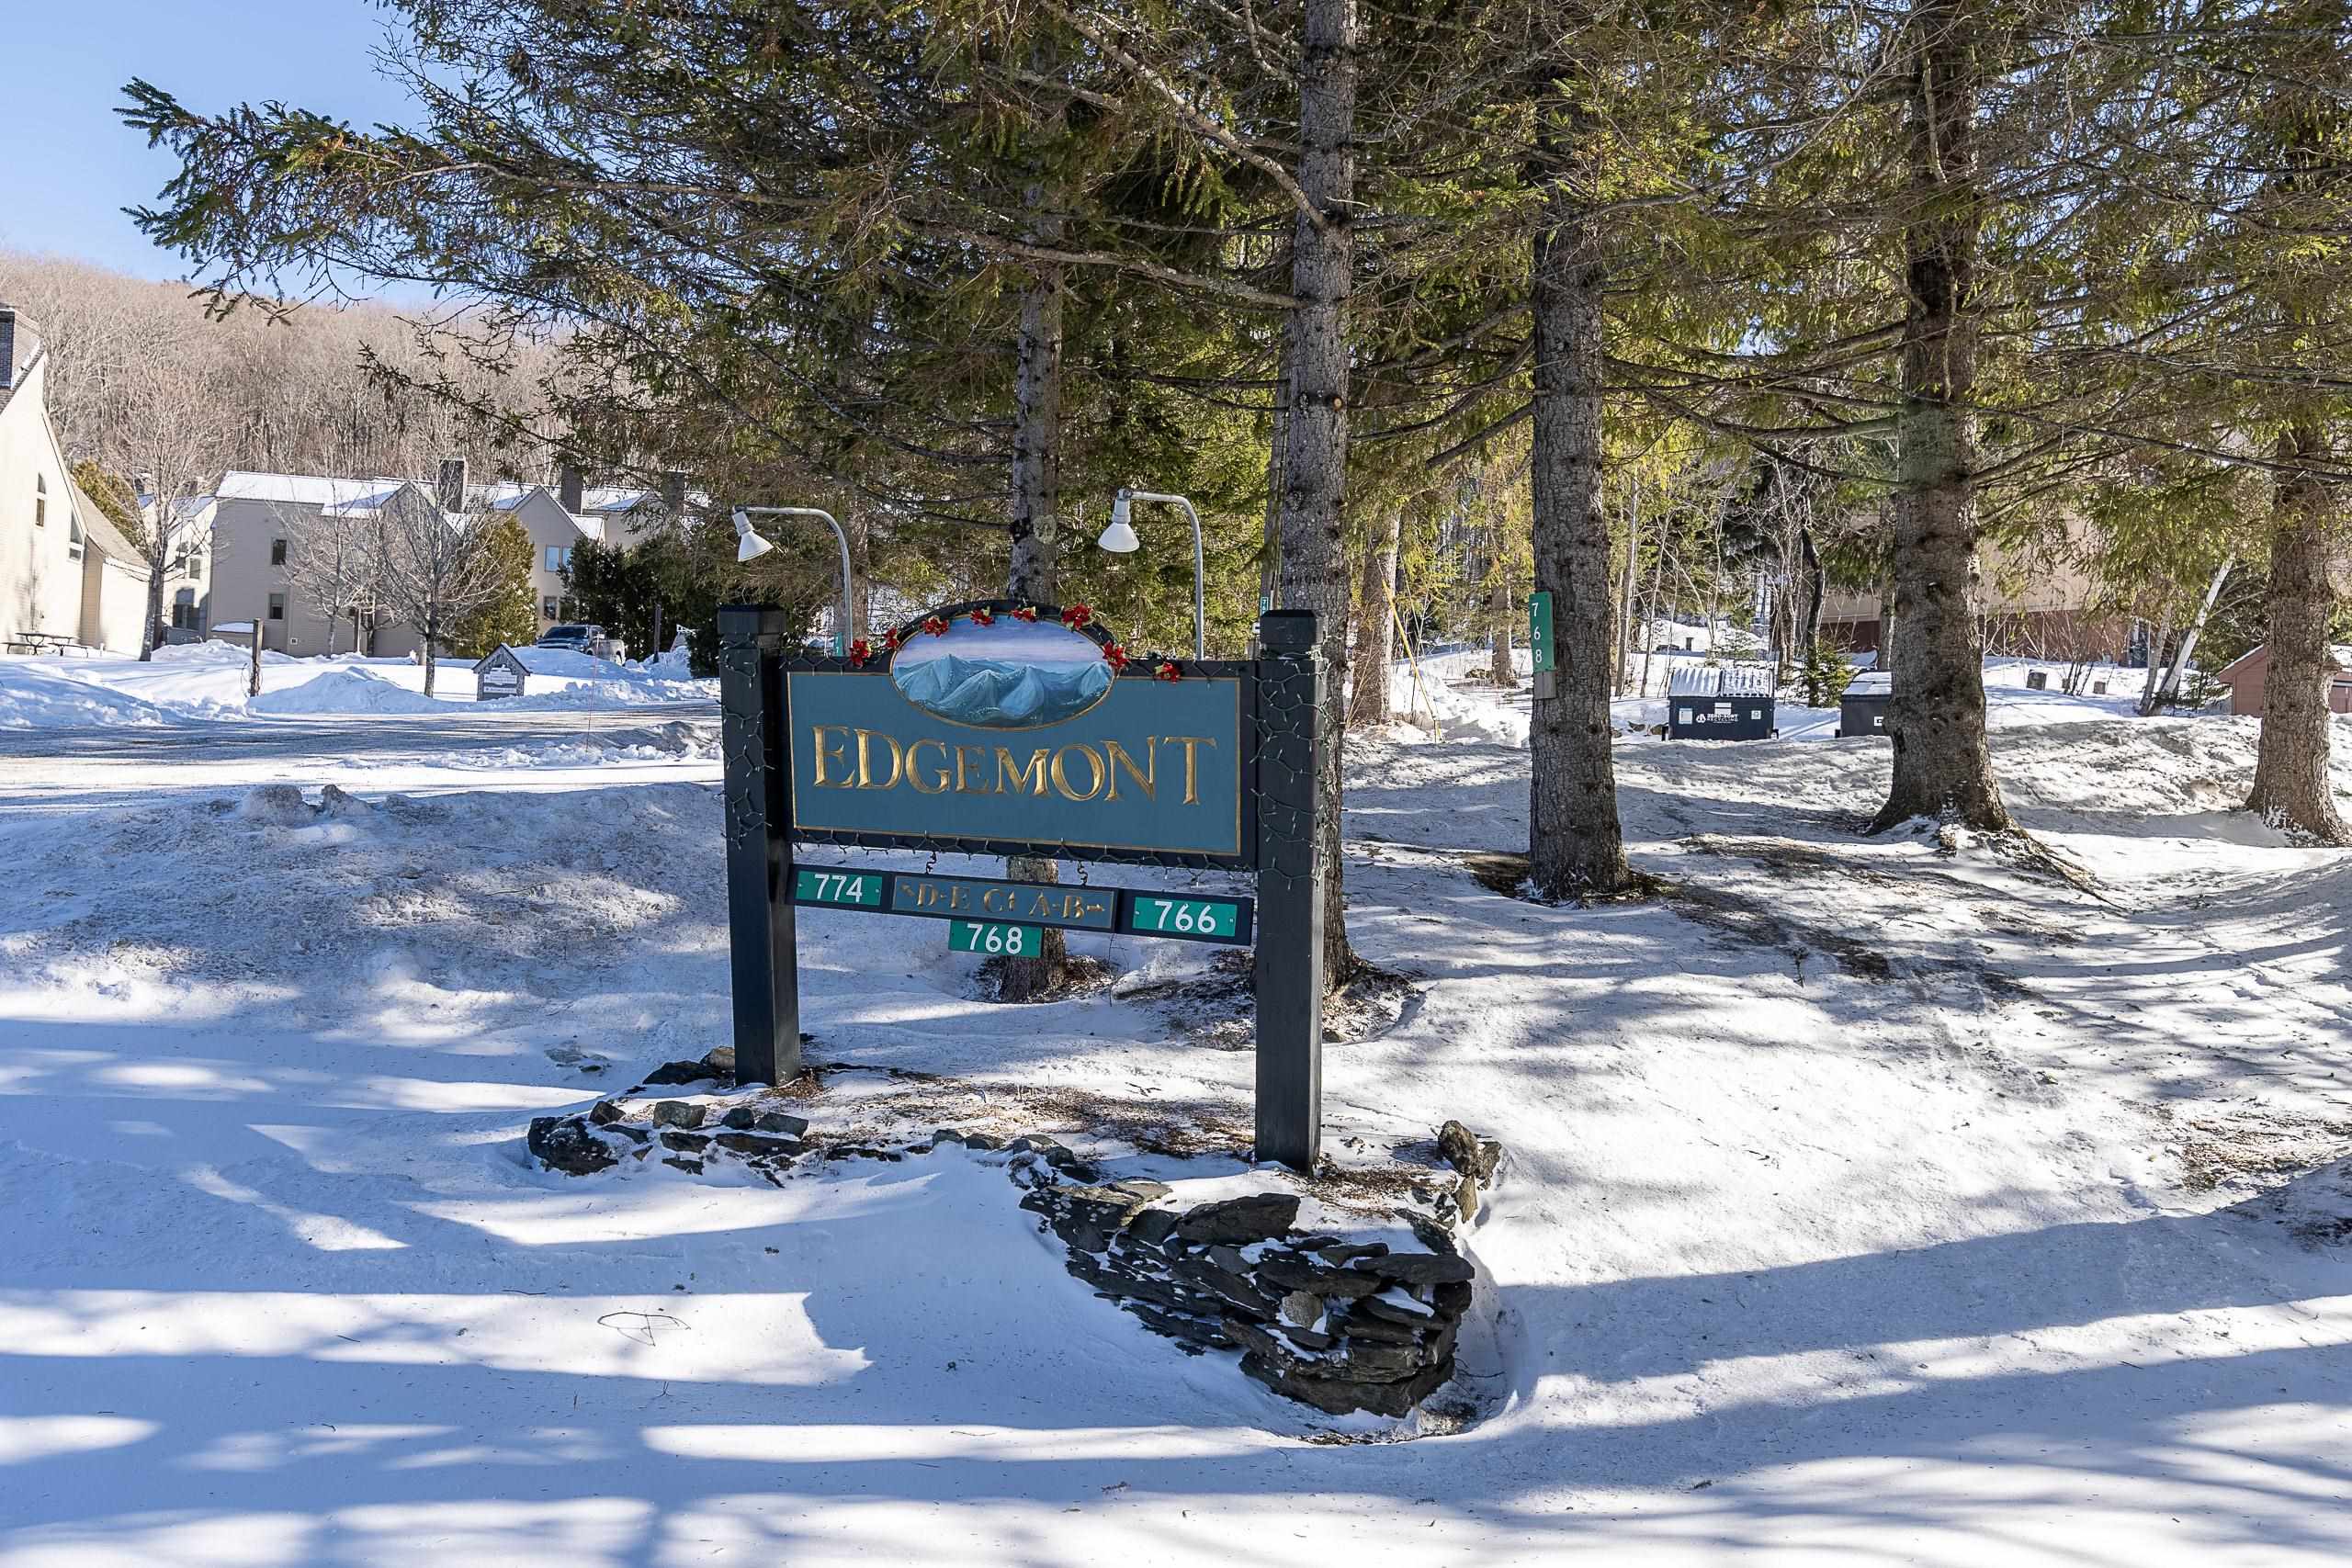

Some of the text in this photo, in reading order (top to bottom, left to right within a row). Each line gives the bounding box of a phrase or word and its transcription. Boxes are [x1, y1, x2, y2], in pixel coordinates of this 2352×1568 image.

[1532, 602, 1543, 663] 768
[812, 726, 1217, 805] EDGEMONT
[814, 874, 862, 902] 774
[984, 888, 1004, 912] C
[1155, 900, 1216, 933] 766
[967, 923, 1022, 954] 768
